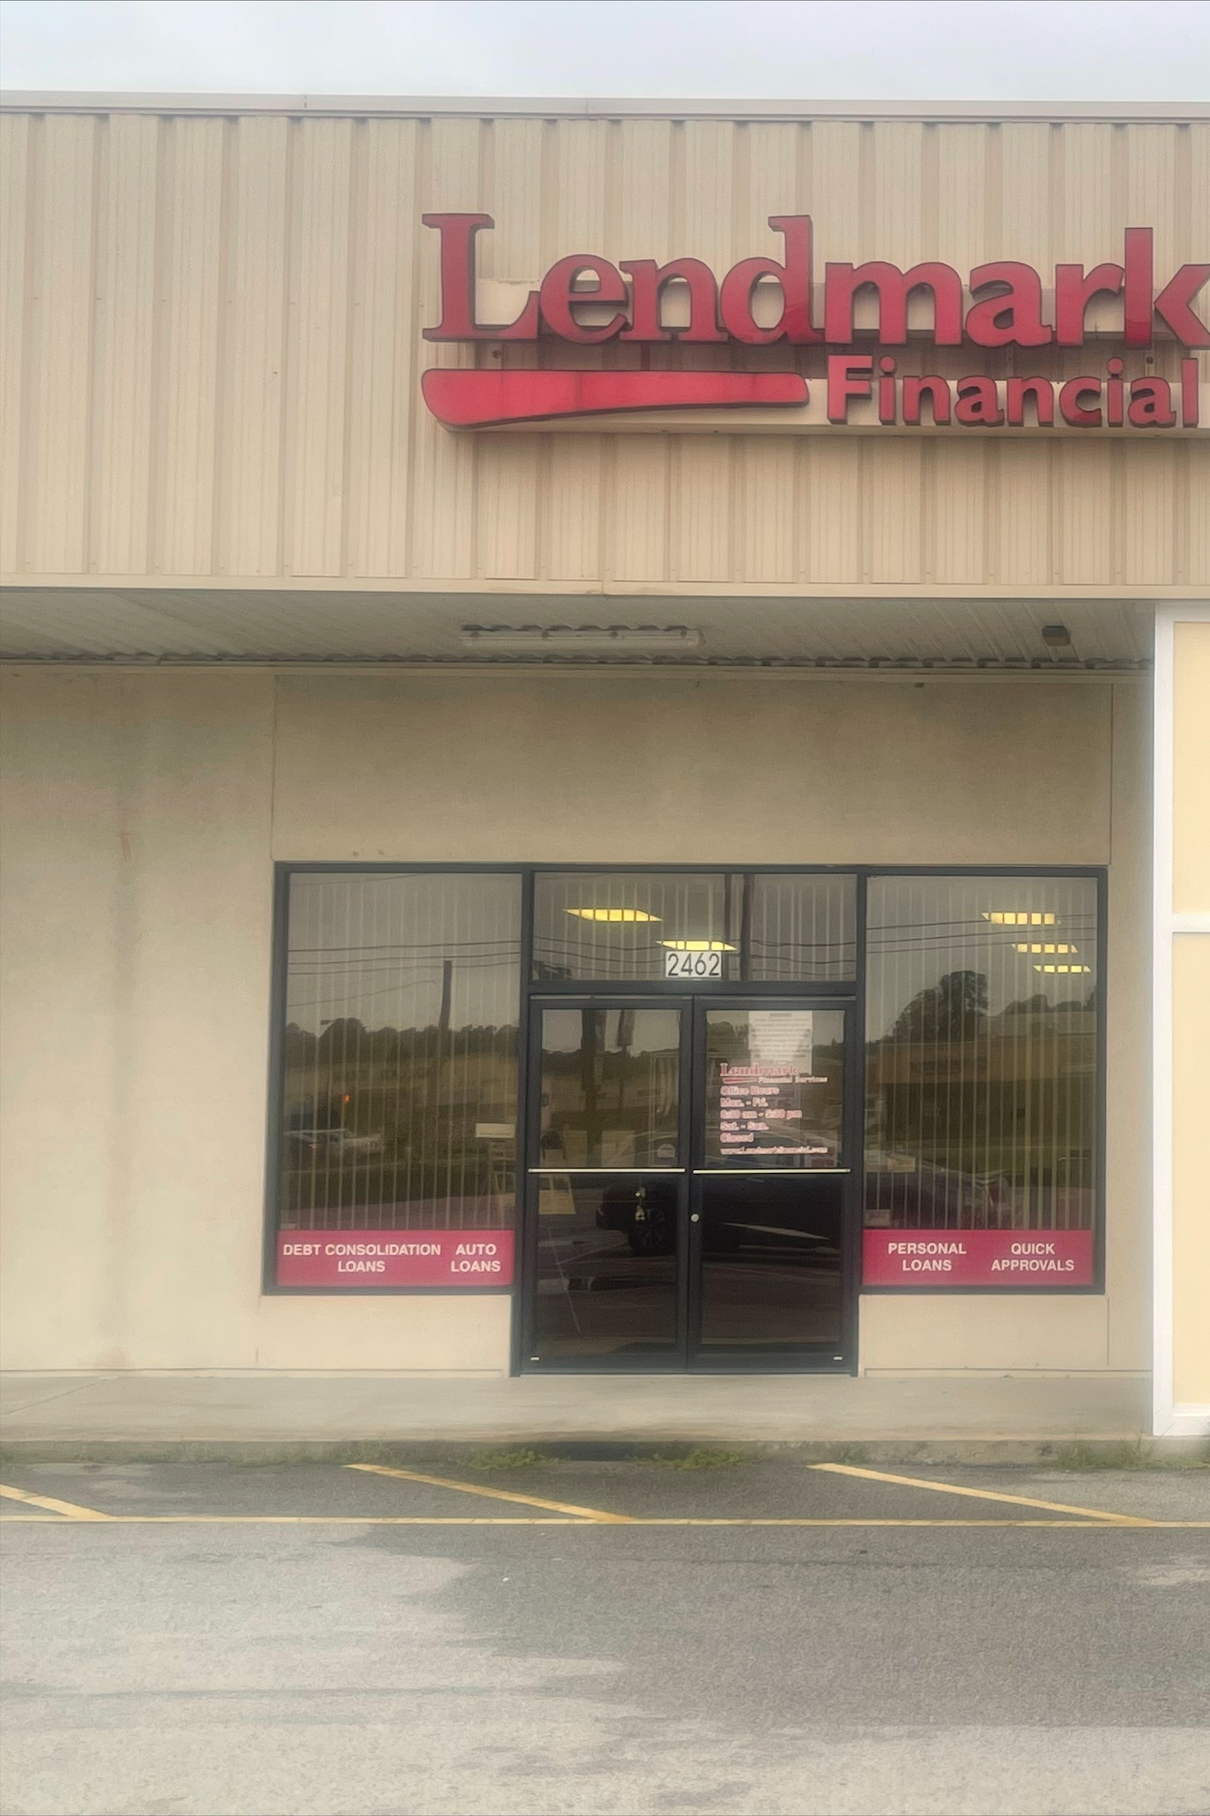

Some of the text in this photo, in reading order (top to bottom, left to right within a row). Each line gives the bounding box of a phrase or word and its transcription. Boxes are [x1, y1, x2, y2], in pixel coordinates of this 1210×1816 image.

[826, 356, 1199, 427] Financial
[667, 953, 721, 976] 2462
[720, 1063, 799, 1077] Lendmark
[283, 1243, 442, 1256] DEBT CONSOLIDATION
[455, 1243, 497, 1256] AUTO
[888, 1242, 967, 1255] PERSONAL
[1010, 1242, 1055, 1255] QUICK
[338, 1260, 386, 1272] LOANS
[451, 1260, 501, 1272] LOANS
[902, 1258, 952, 1271] LOANS
[991, 1258, 1075, 1271] APPROVALS
